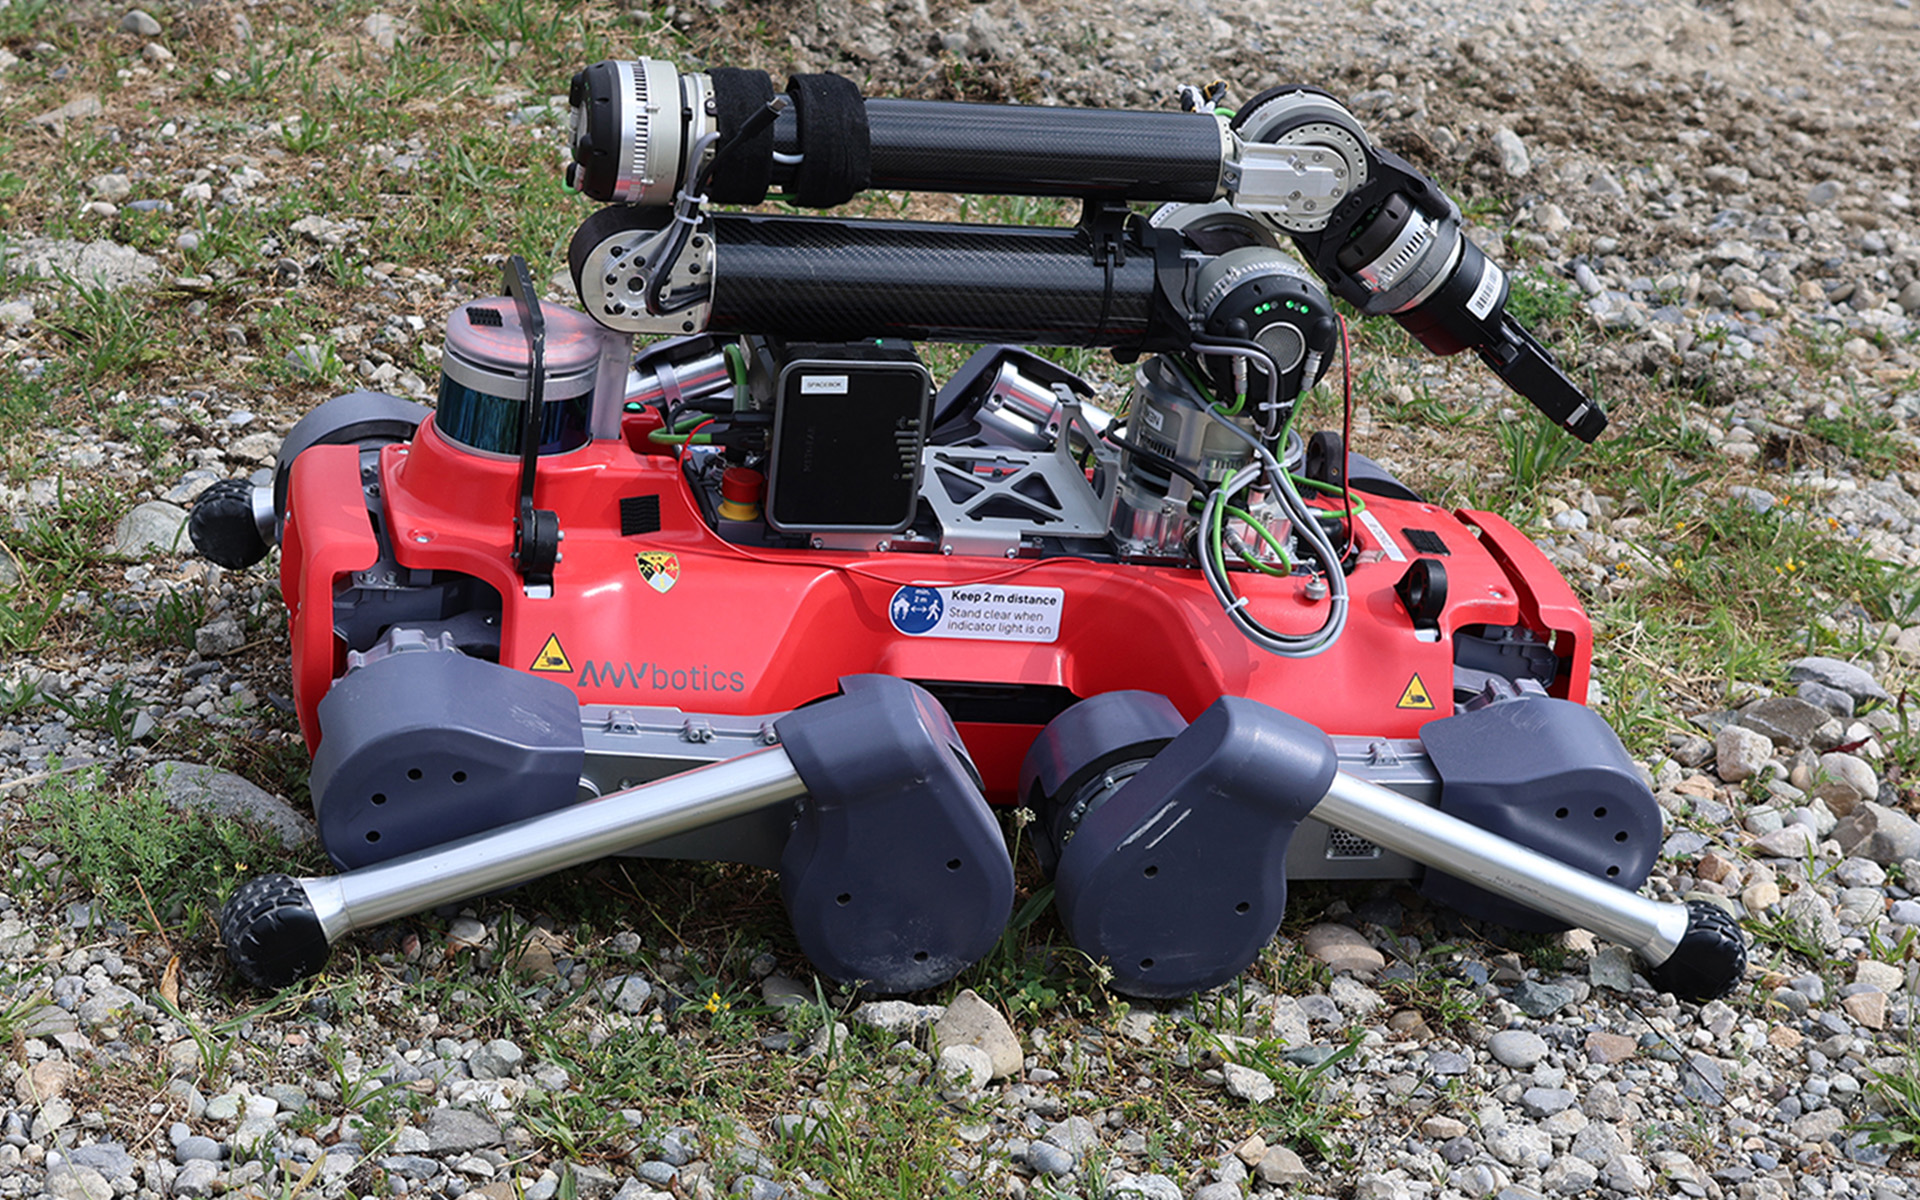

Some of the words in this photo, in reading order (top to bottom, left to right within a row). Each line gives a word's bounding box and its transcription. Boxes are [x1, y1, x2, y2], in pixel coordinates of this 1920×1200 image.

[951, 591, 982, 603] Keep
[983, 592, 992, 602] 2
[993, 594, 1005, 603] m
[1007, 593, 1057, 606] distance
[949, 606, 982, 619] Stand
[983, 609, 1012, 620] clear
[1013, 611, 1044, 622] when
[947, 620, 996, 632] indicator
[998, 622, 1023, 635] light
[1025, 624, 1035, 634] is
[1036, 625, 1052, 635] on
